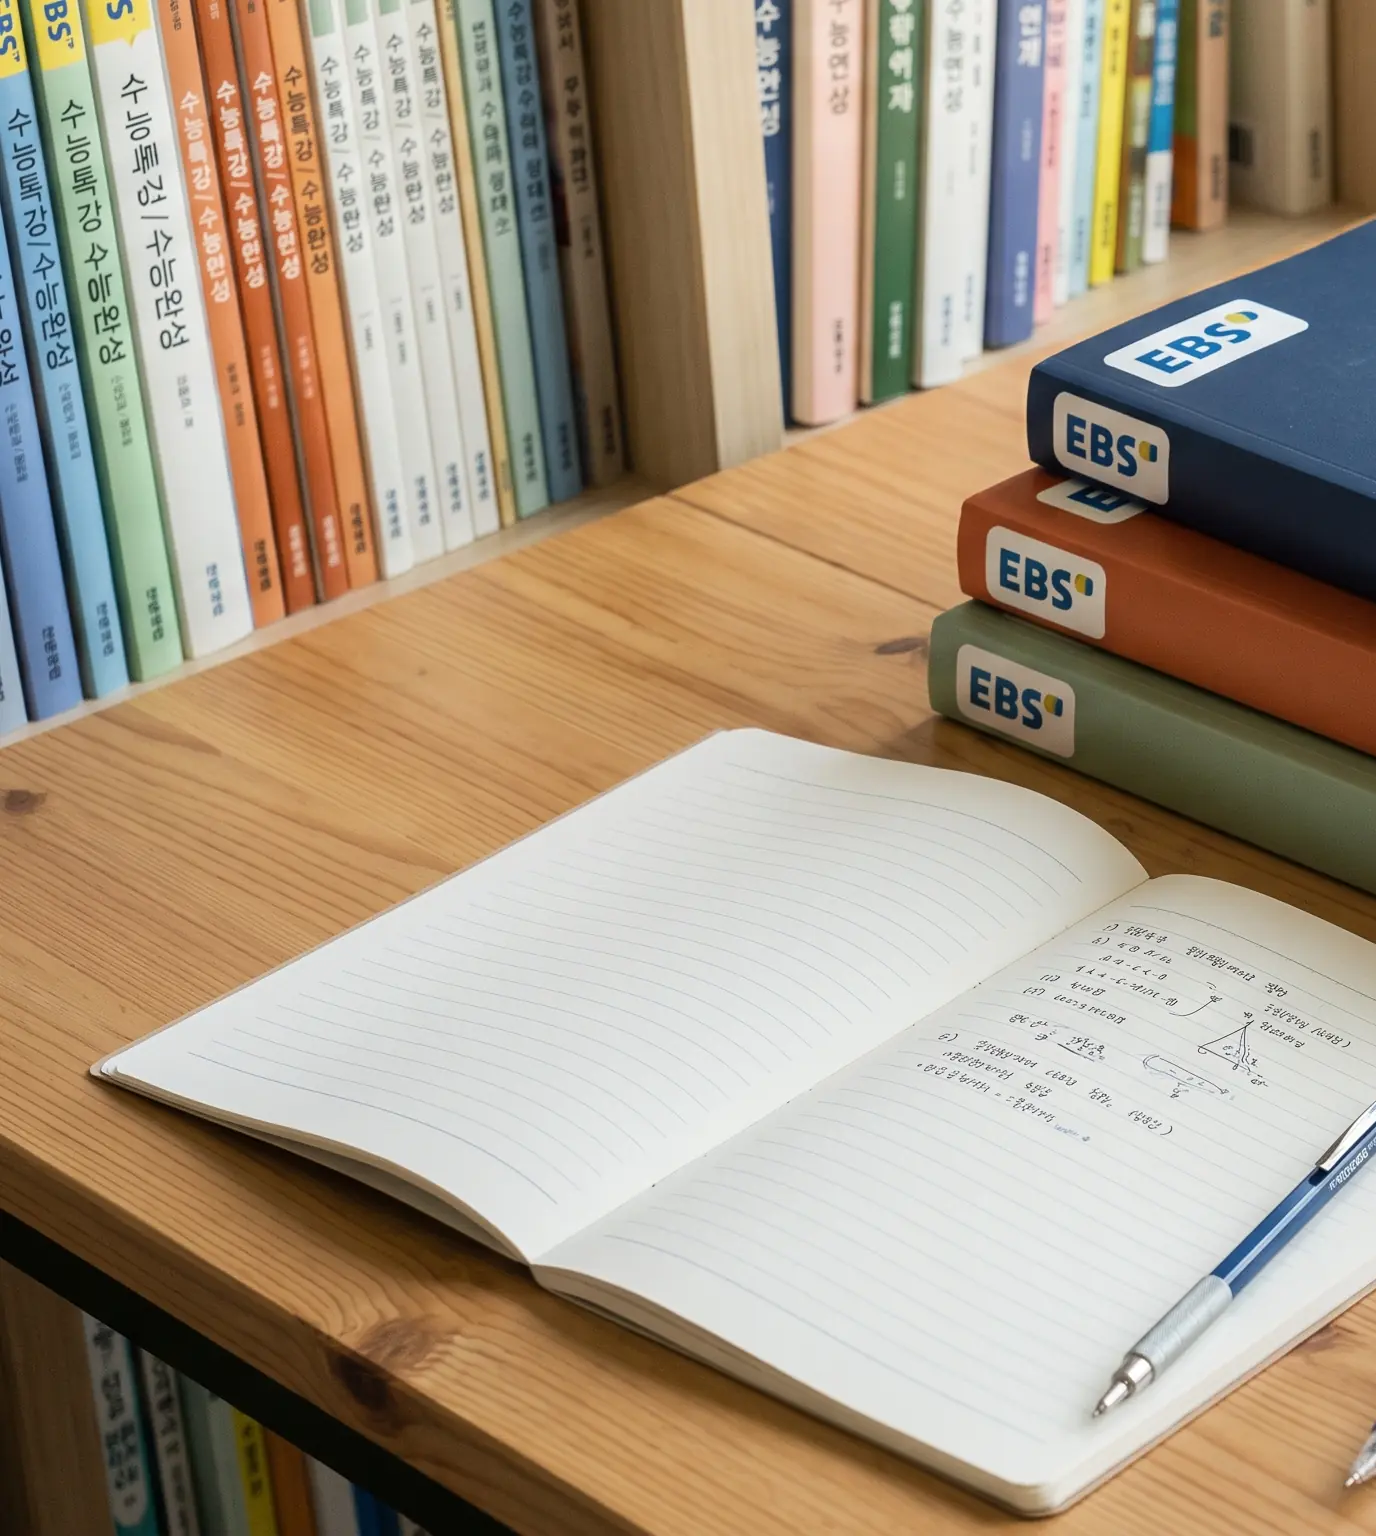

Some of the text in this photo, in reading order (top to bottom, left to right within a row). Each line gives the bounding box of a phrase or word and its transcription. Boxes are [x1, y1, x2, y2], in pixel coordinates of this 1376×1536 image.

[1134, 321, 1252, 374] EBS
[1066, 413, 1138, 477] EBS
[1000, 547, 1073, 611] EBS
[970, 665, 1043, 730] EBS
